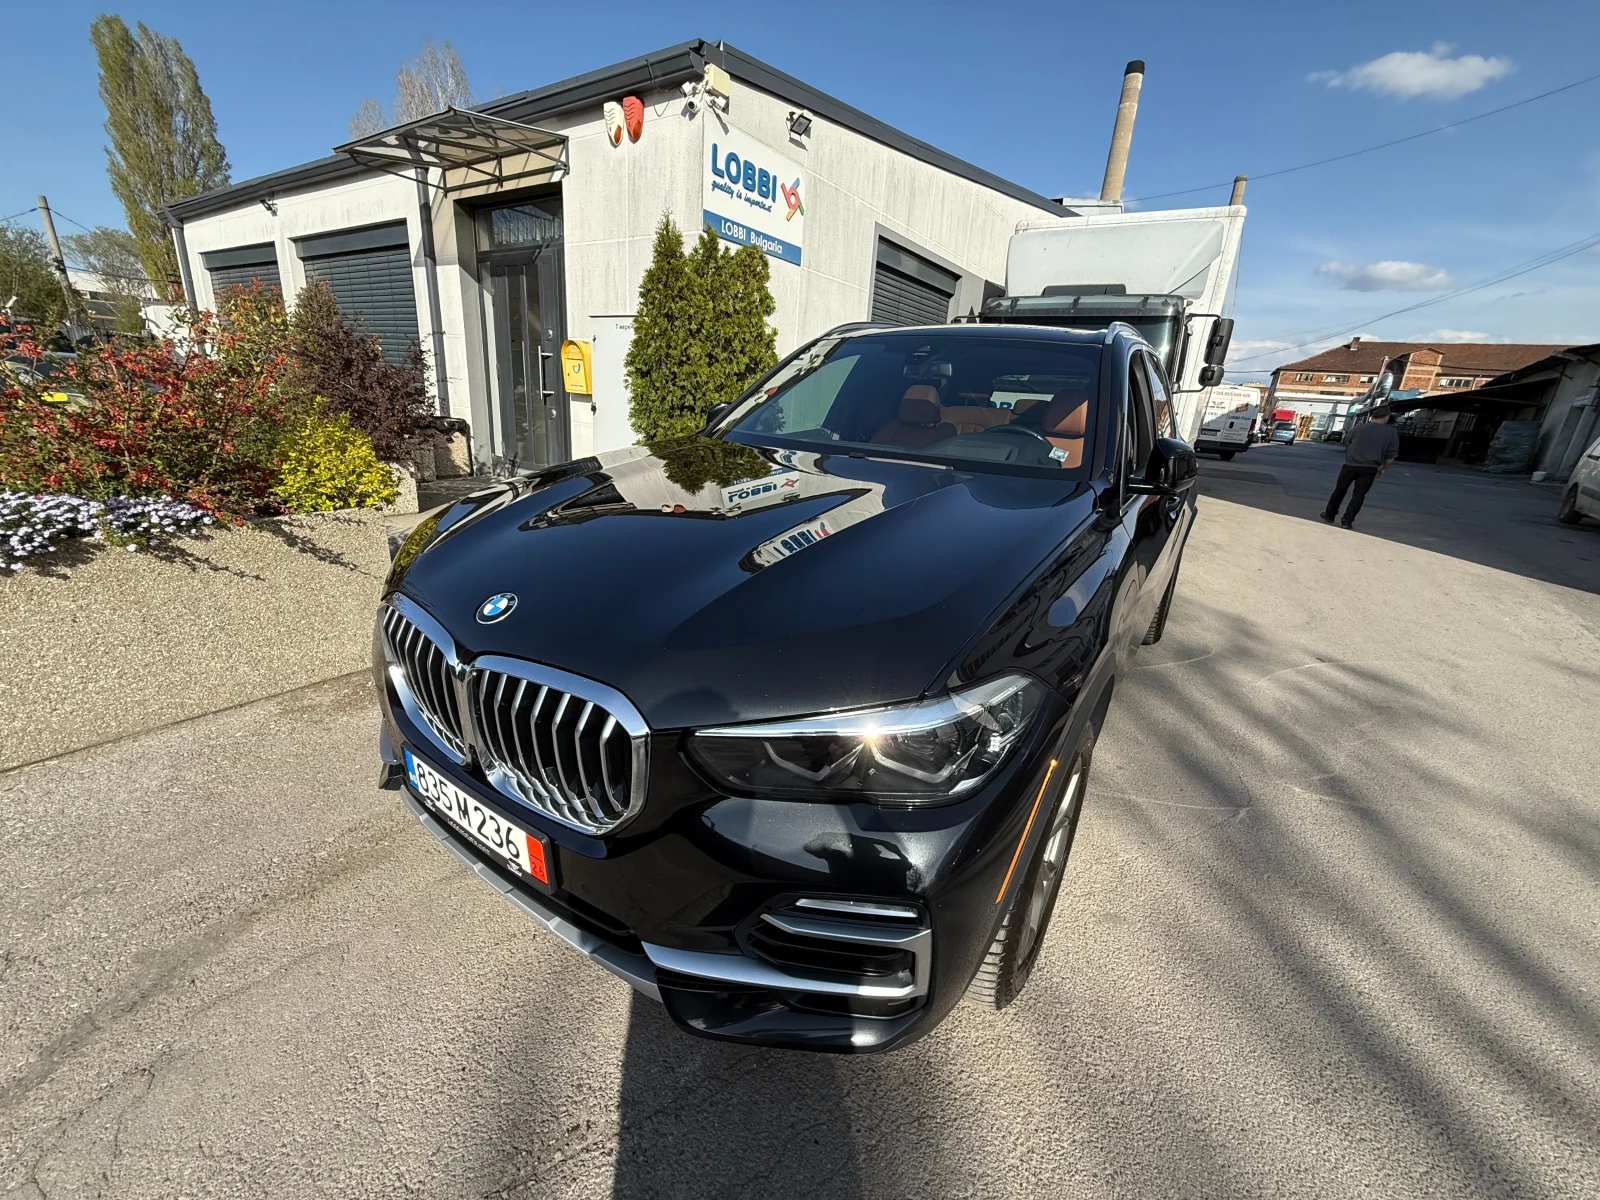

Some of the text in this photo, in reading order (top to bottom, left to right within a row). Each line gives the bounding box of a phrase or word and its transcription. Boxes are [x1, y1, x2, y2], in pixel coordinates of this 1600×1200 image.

[712, 143, 778, 203] LOBBI
[711, 180, 773, 213] quality is important
[721, 220, 783, 255] LOBBI Bulgaria
[532, 861, 545, 878] 26
